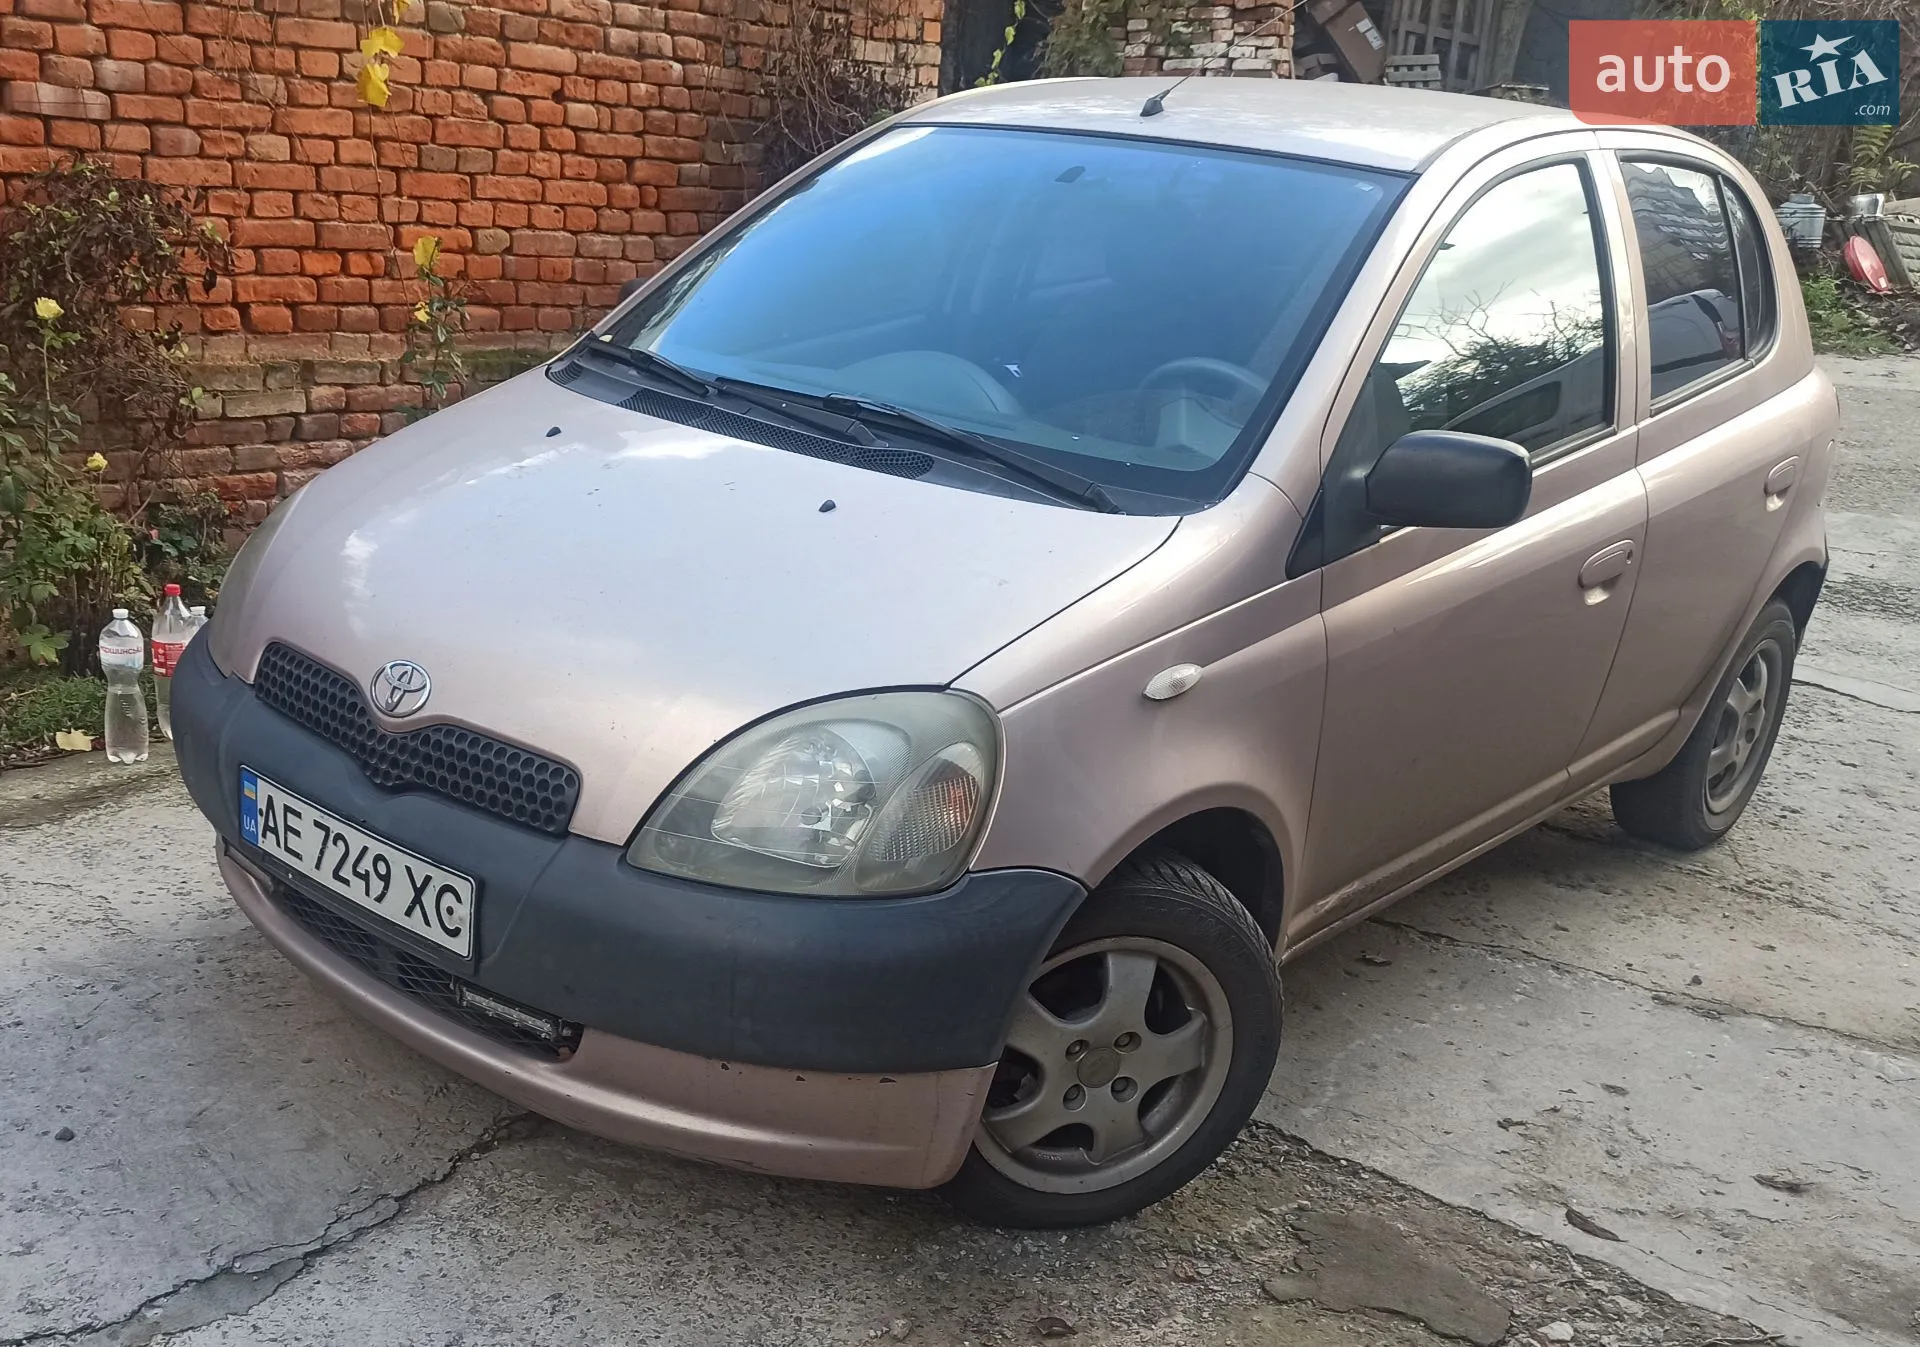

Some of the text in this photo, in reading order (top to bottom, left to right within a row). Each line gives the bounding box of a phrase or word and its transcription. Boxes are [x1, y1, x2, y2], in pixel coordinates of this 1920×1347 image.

[243, 814, 257, 834] UA
[261, 793, 463, 938] AE 7249 XC
